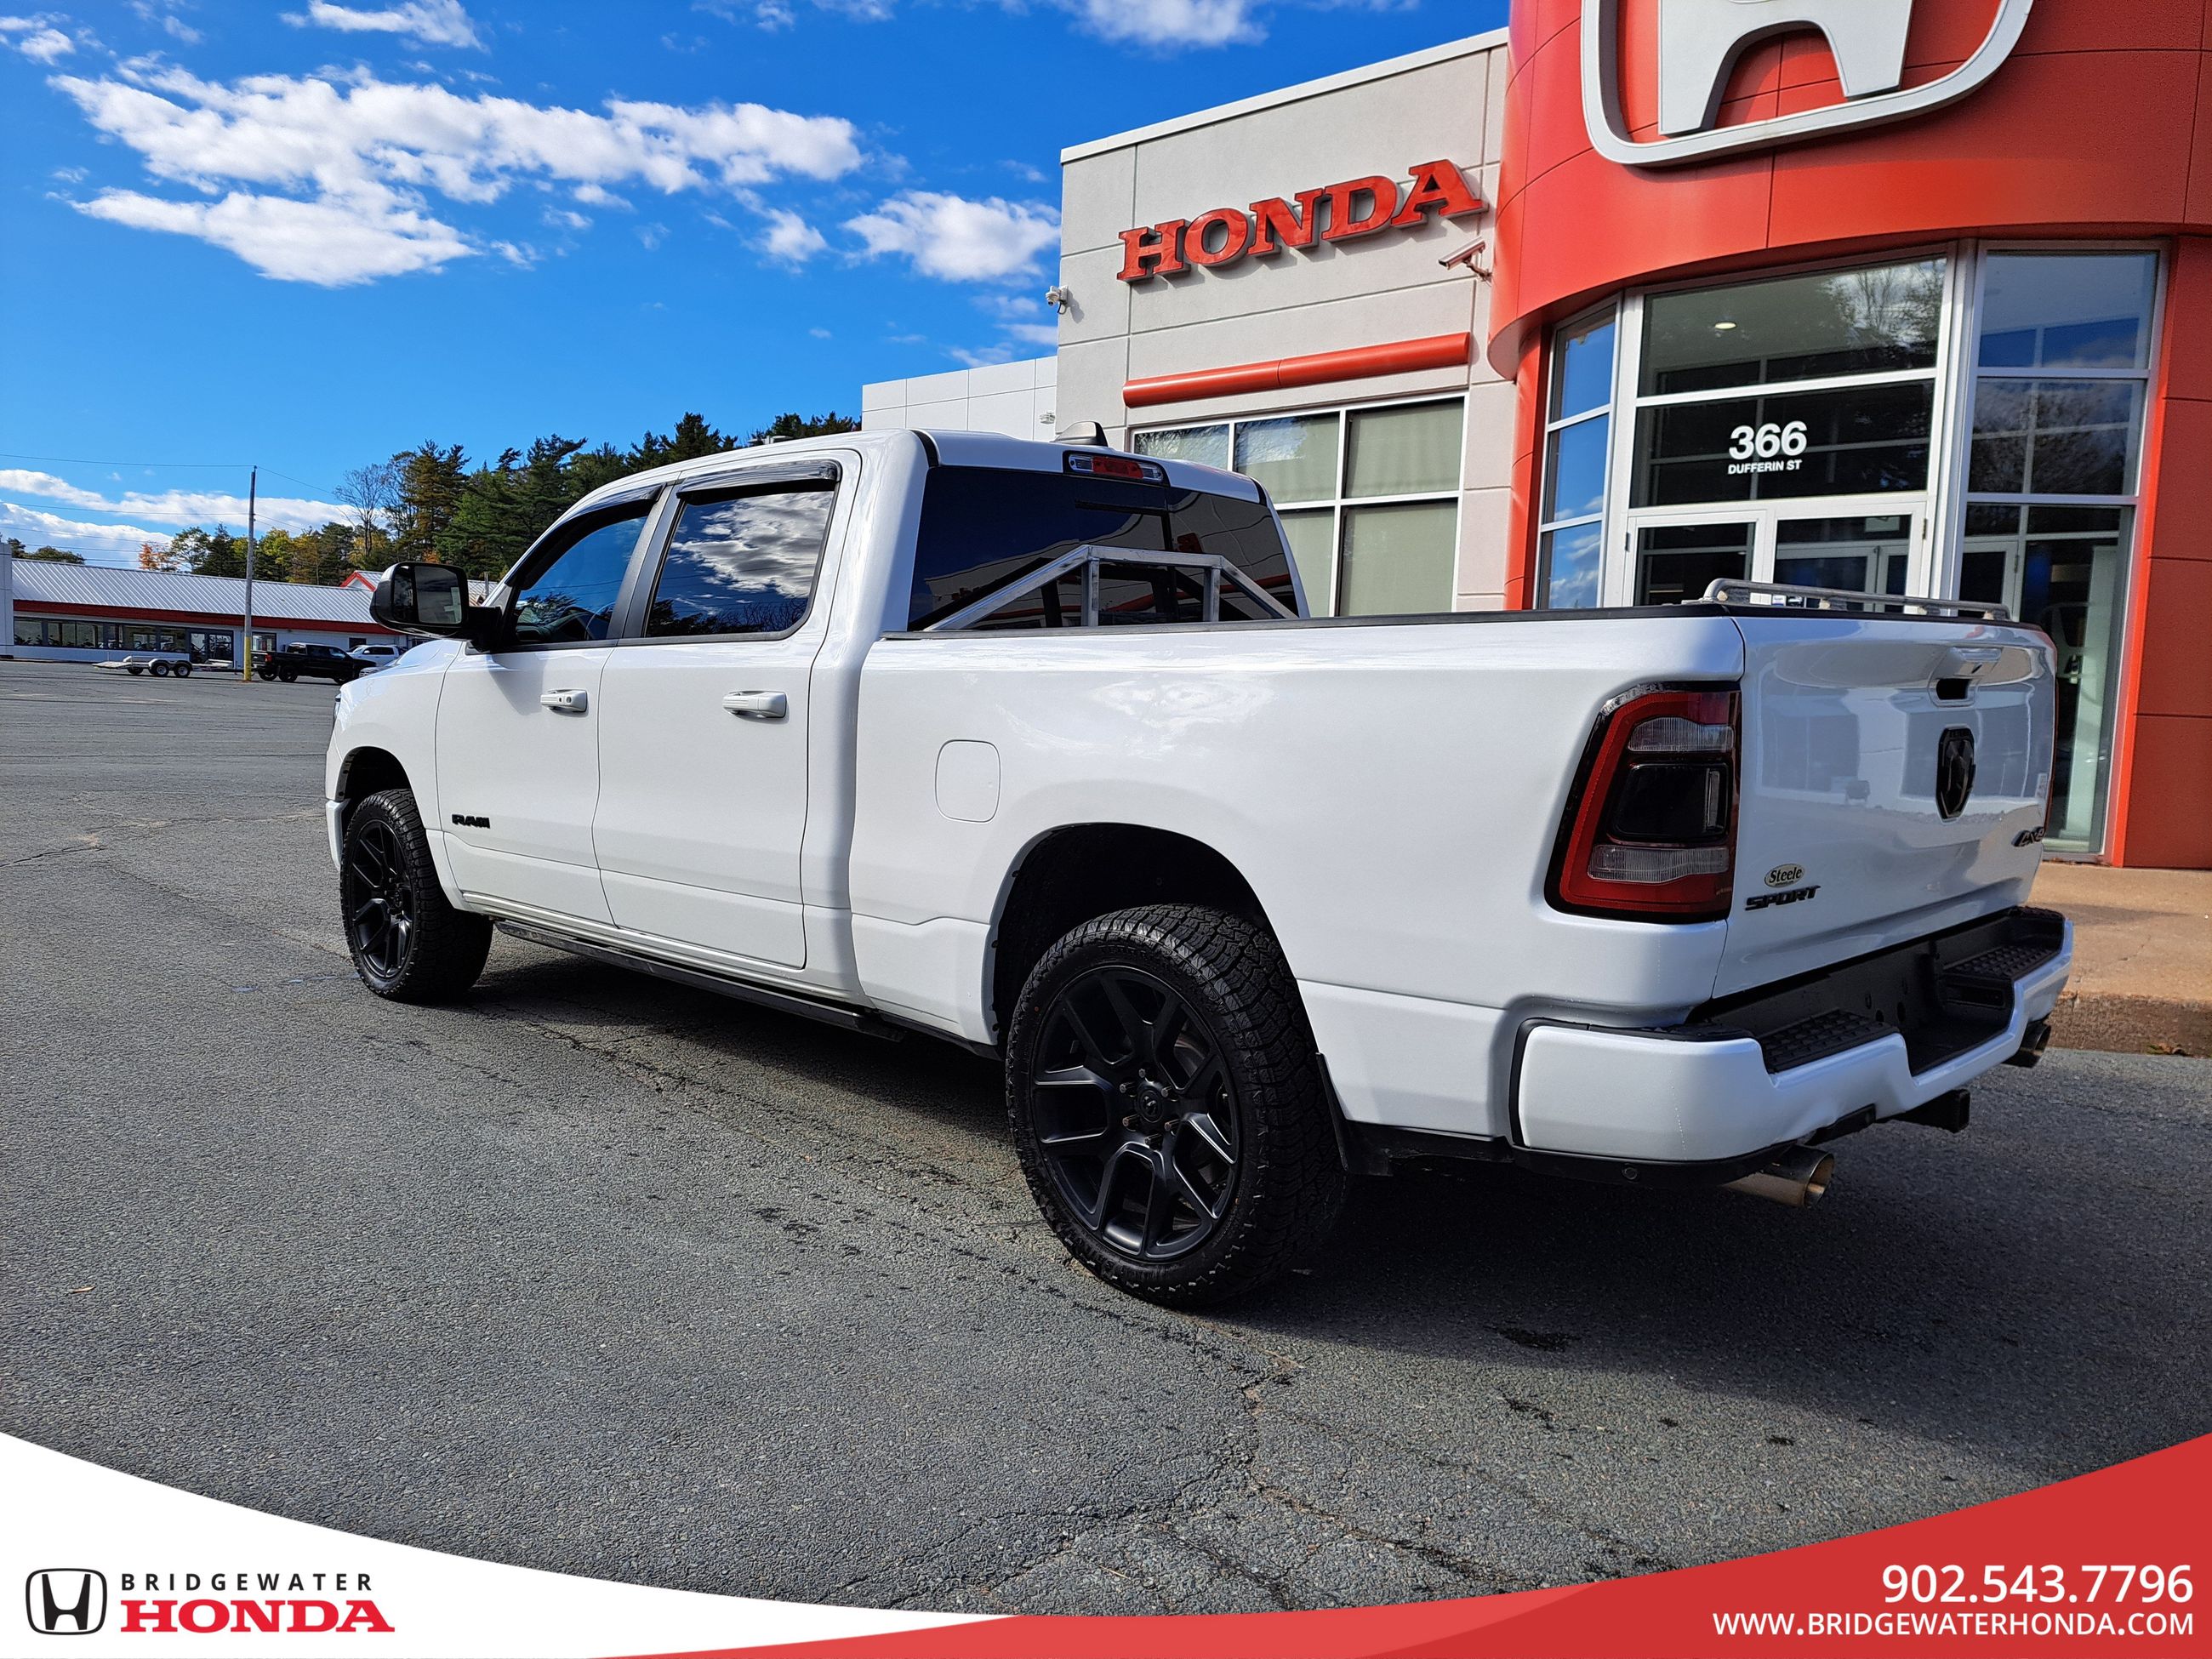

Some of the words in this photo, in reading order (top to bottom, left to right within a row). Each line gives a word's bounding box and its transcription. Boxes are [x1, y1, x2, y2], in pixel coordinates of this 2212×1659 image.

[1116, 158, 1487, 282] HONDA
[1729, 420, 1808, 460] 366
[1727, 460, 1785, 475] DUFFERIN
[1786, 459, 1803, 471] ST
[451, 813, 491, 829] RAM
[1769, 866, 1803, 884] Steele
[1745, 884, 1821, 911] SPORT
